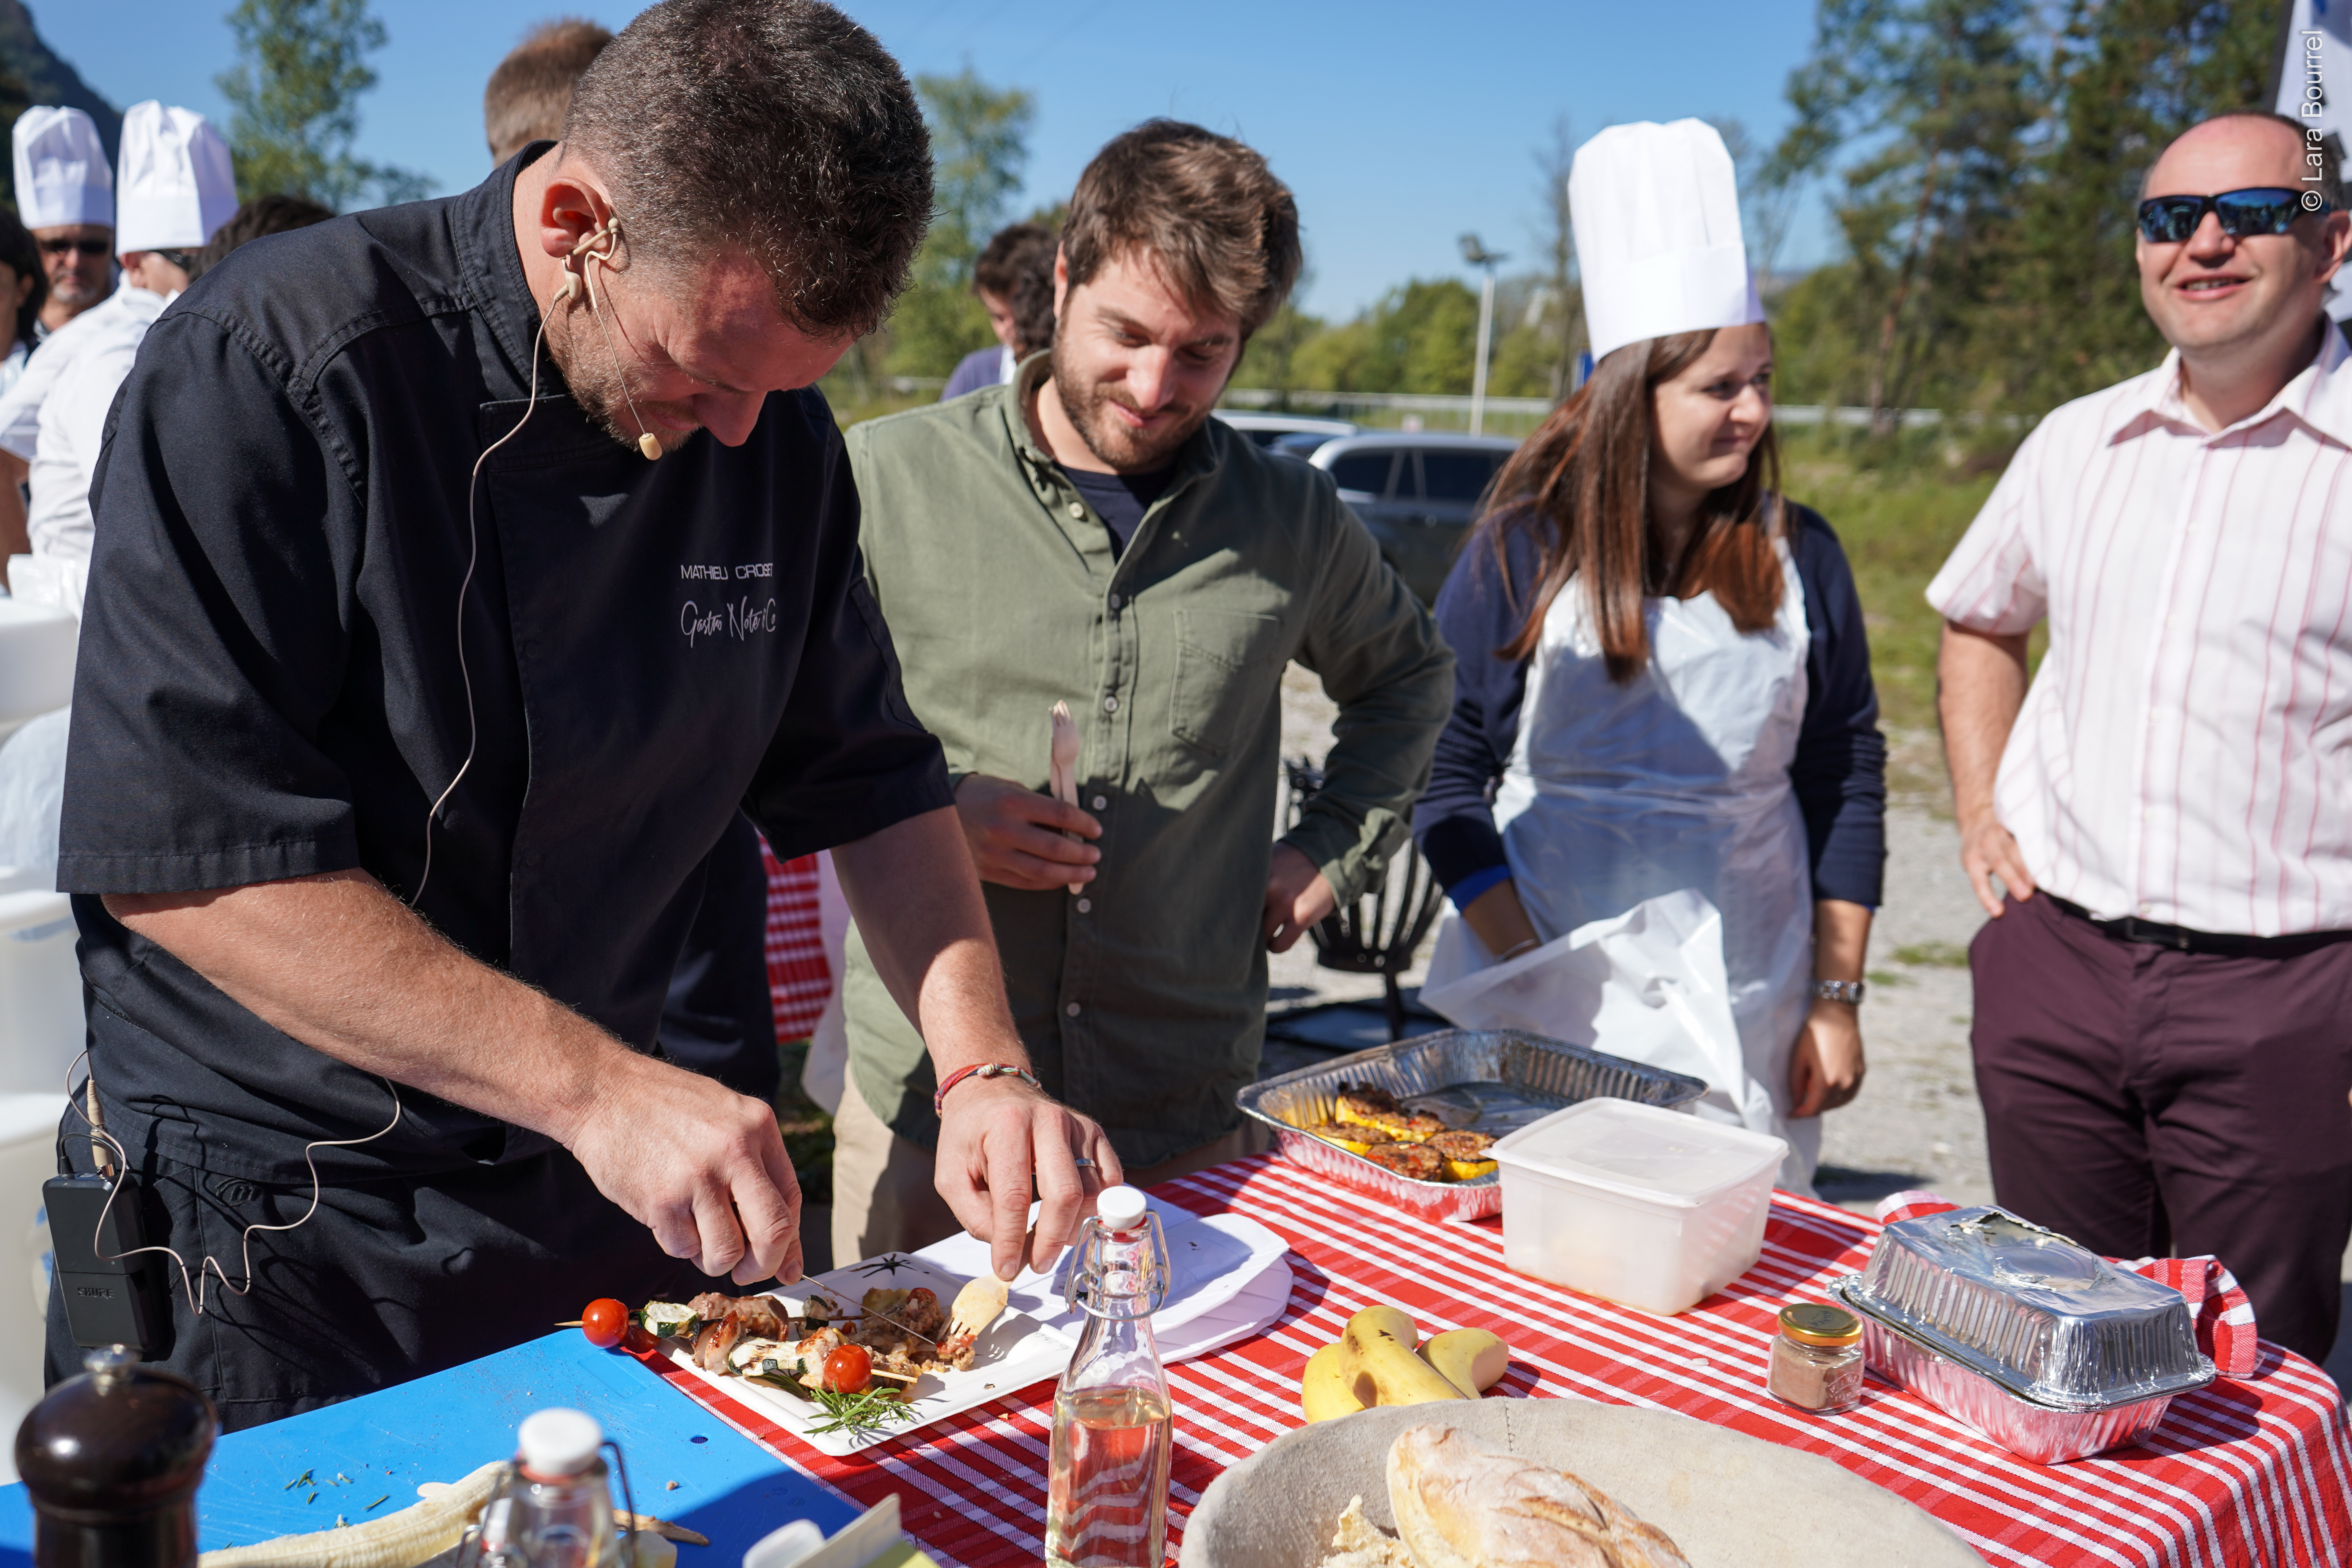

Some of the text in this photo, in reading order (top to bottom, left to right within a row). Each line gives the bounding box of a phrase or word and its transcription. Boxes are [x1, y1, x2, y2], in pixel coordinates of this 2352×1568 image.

[681, 564, 728, 580] MATHIEU
[681, 600, 722, 648] Gastro
[727, 595, 763, 641] Note
[78, 1287, 114, 1300] SHURE
